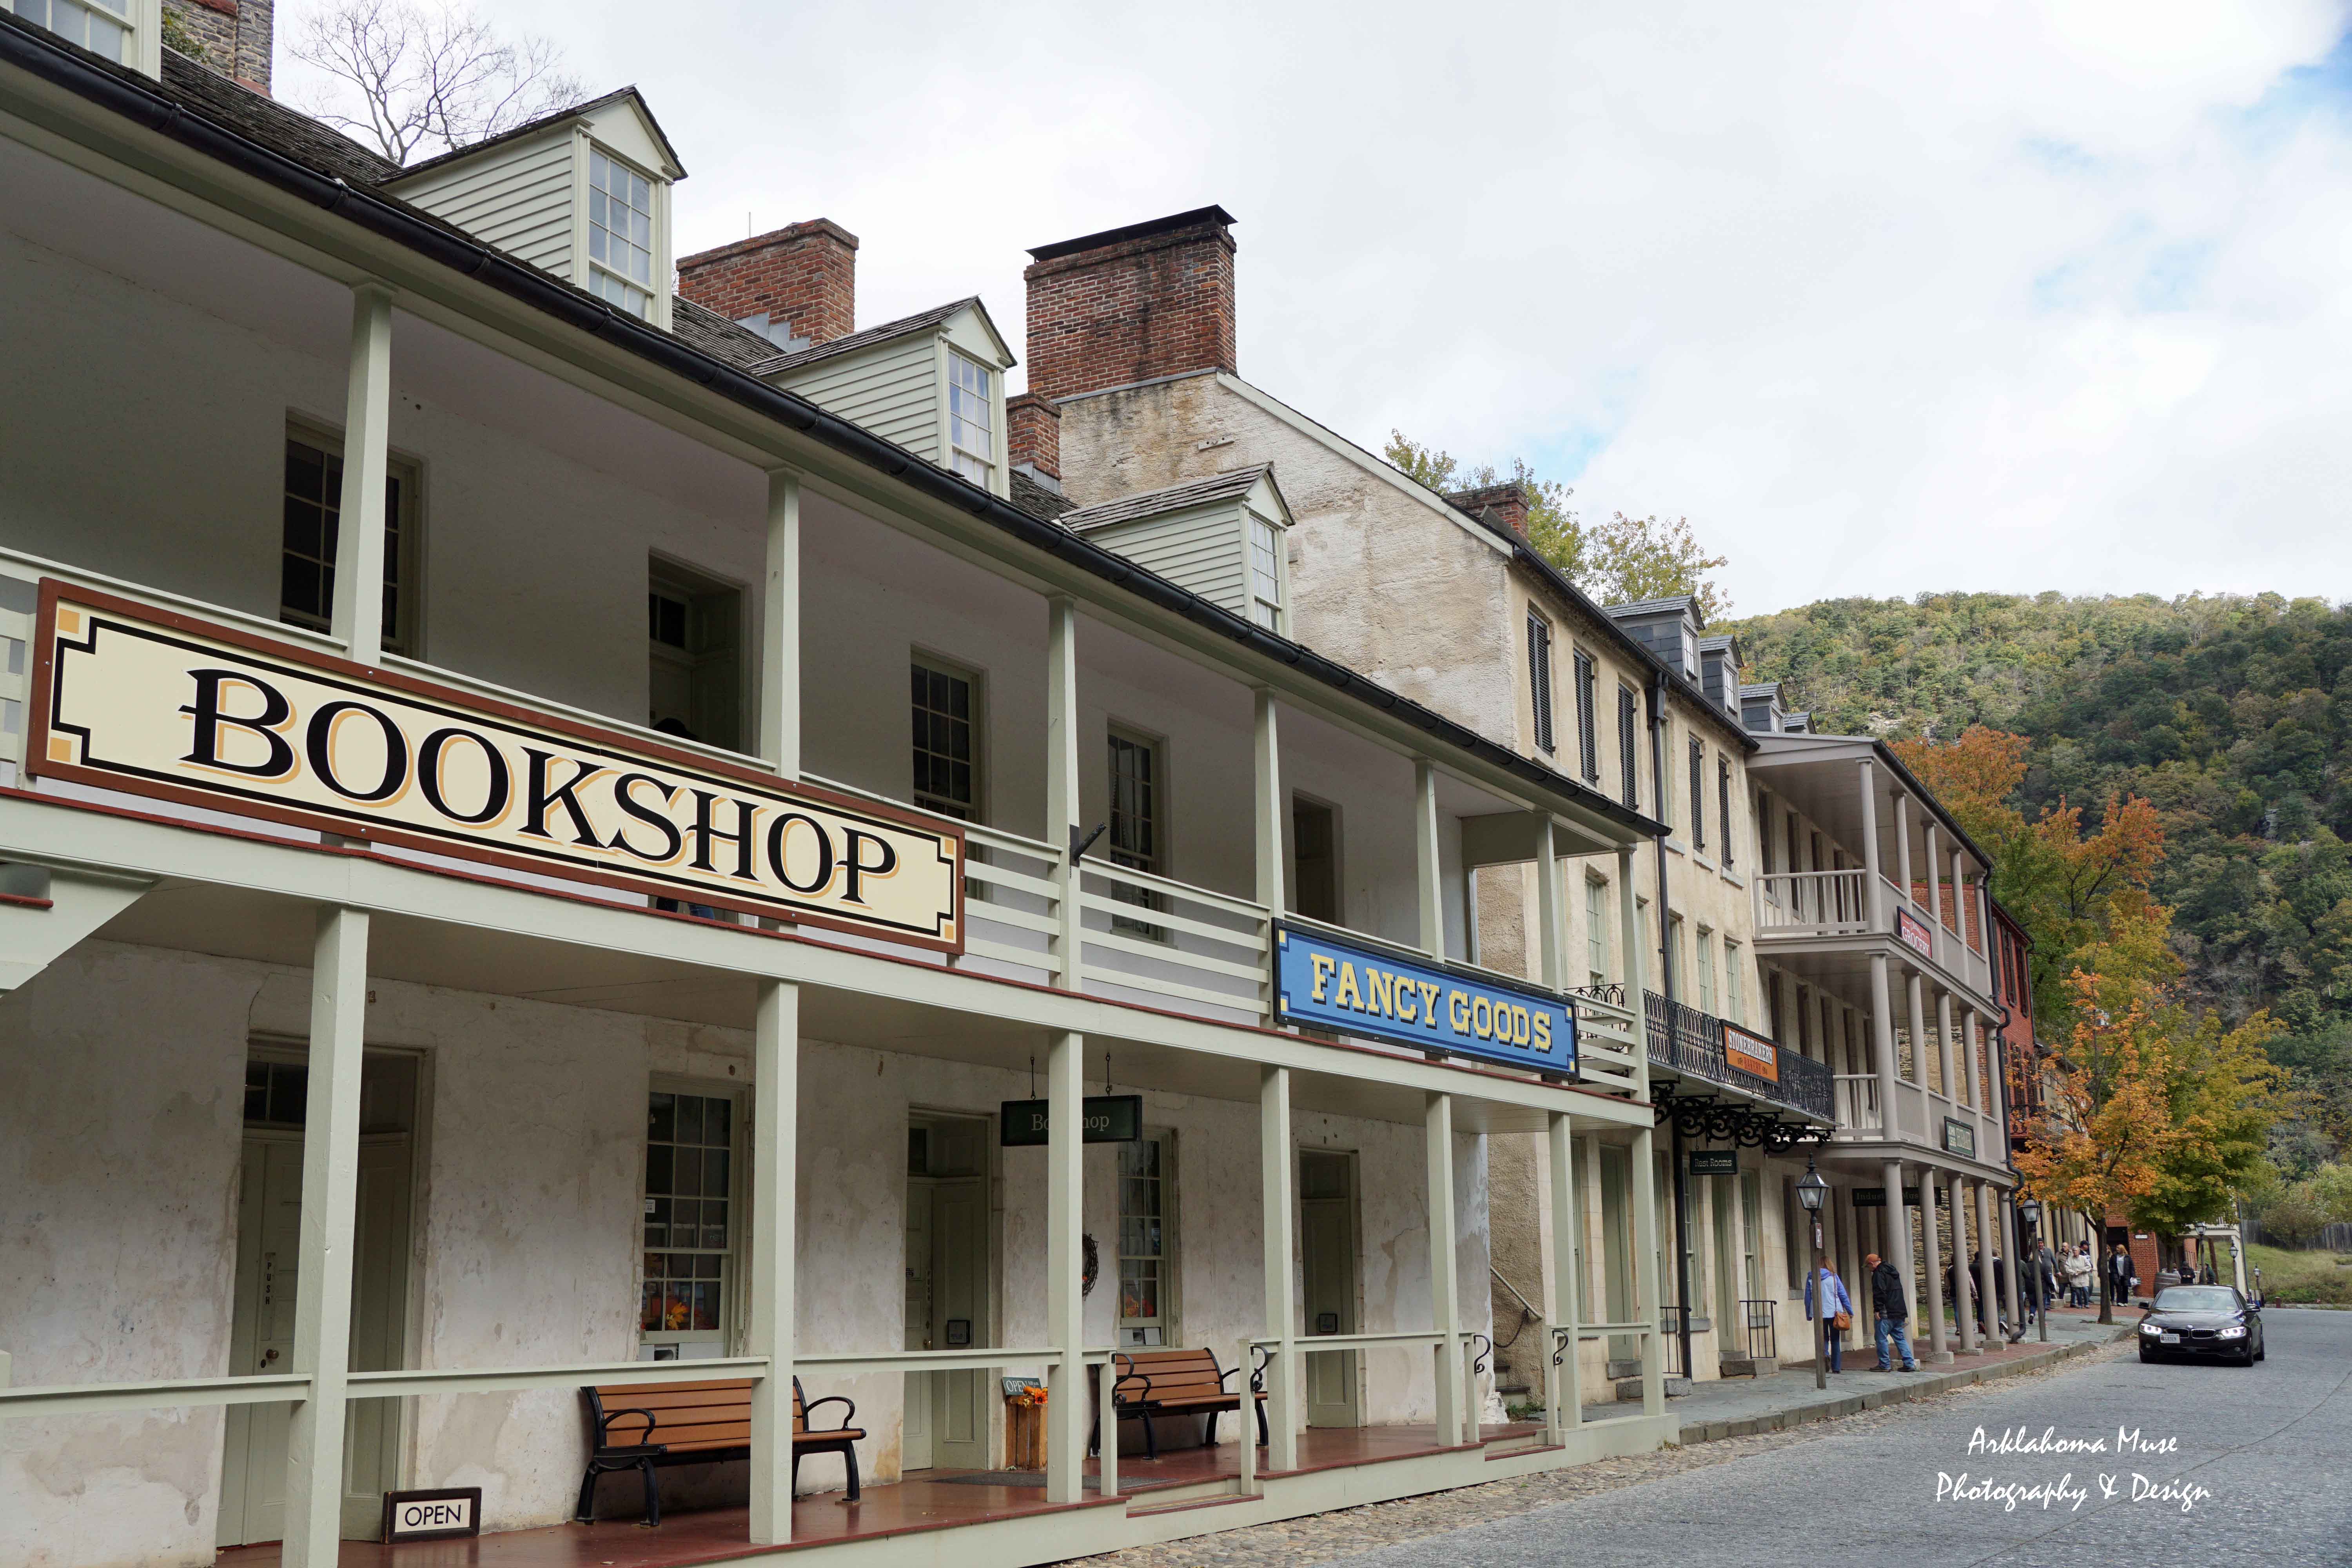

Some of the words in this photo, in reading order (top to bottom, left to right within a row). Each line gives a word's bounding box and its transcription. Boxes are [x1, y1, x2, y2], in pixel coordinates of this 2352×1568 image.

[179, 668, 898, 907] BOOKSHOP
[1902, 926, 1929, 957] GROCERY
[1310, 953, 1441, 1029] FANCY
[1449, 989, 1552, 1053] GOODS
[1728, 1029, 1772, 1065] STONEBRAKERS
[1744, 1057, 1761, 1074] BAKERY
[1695, 1158, 1709, 1167] Rest
[1710, 1158, 1732, 1167] Rooms
[1856, 1192, 1885, 1200] Indust
[1006, 1380, 1027, 1392] OPEN
[405, 1504, 461, 1526] OPEN
